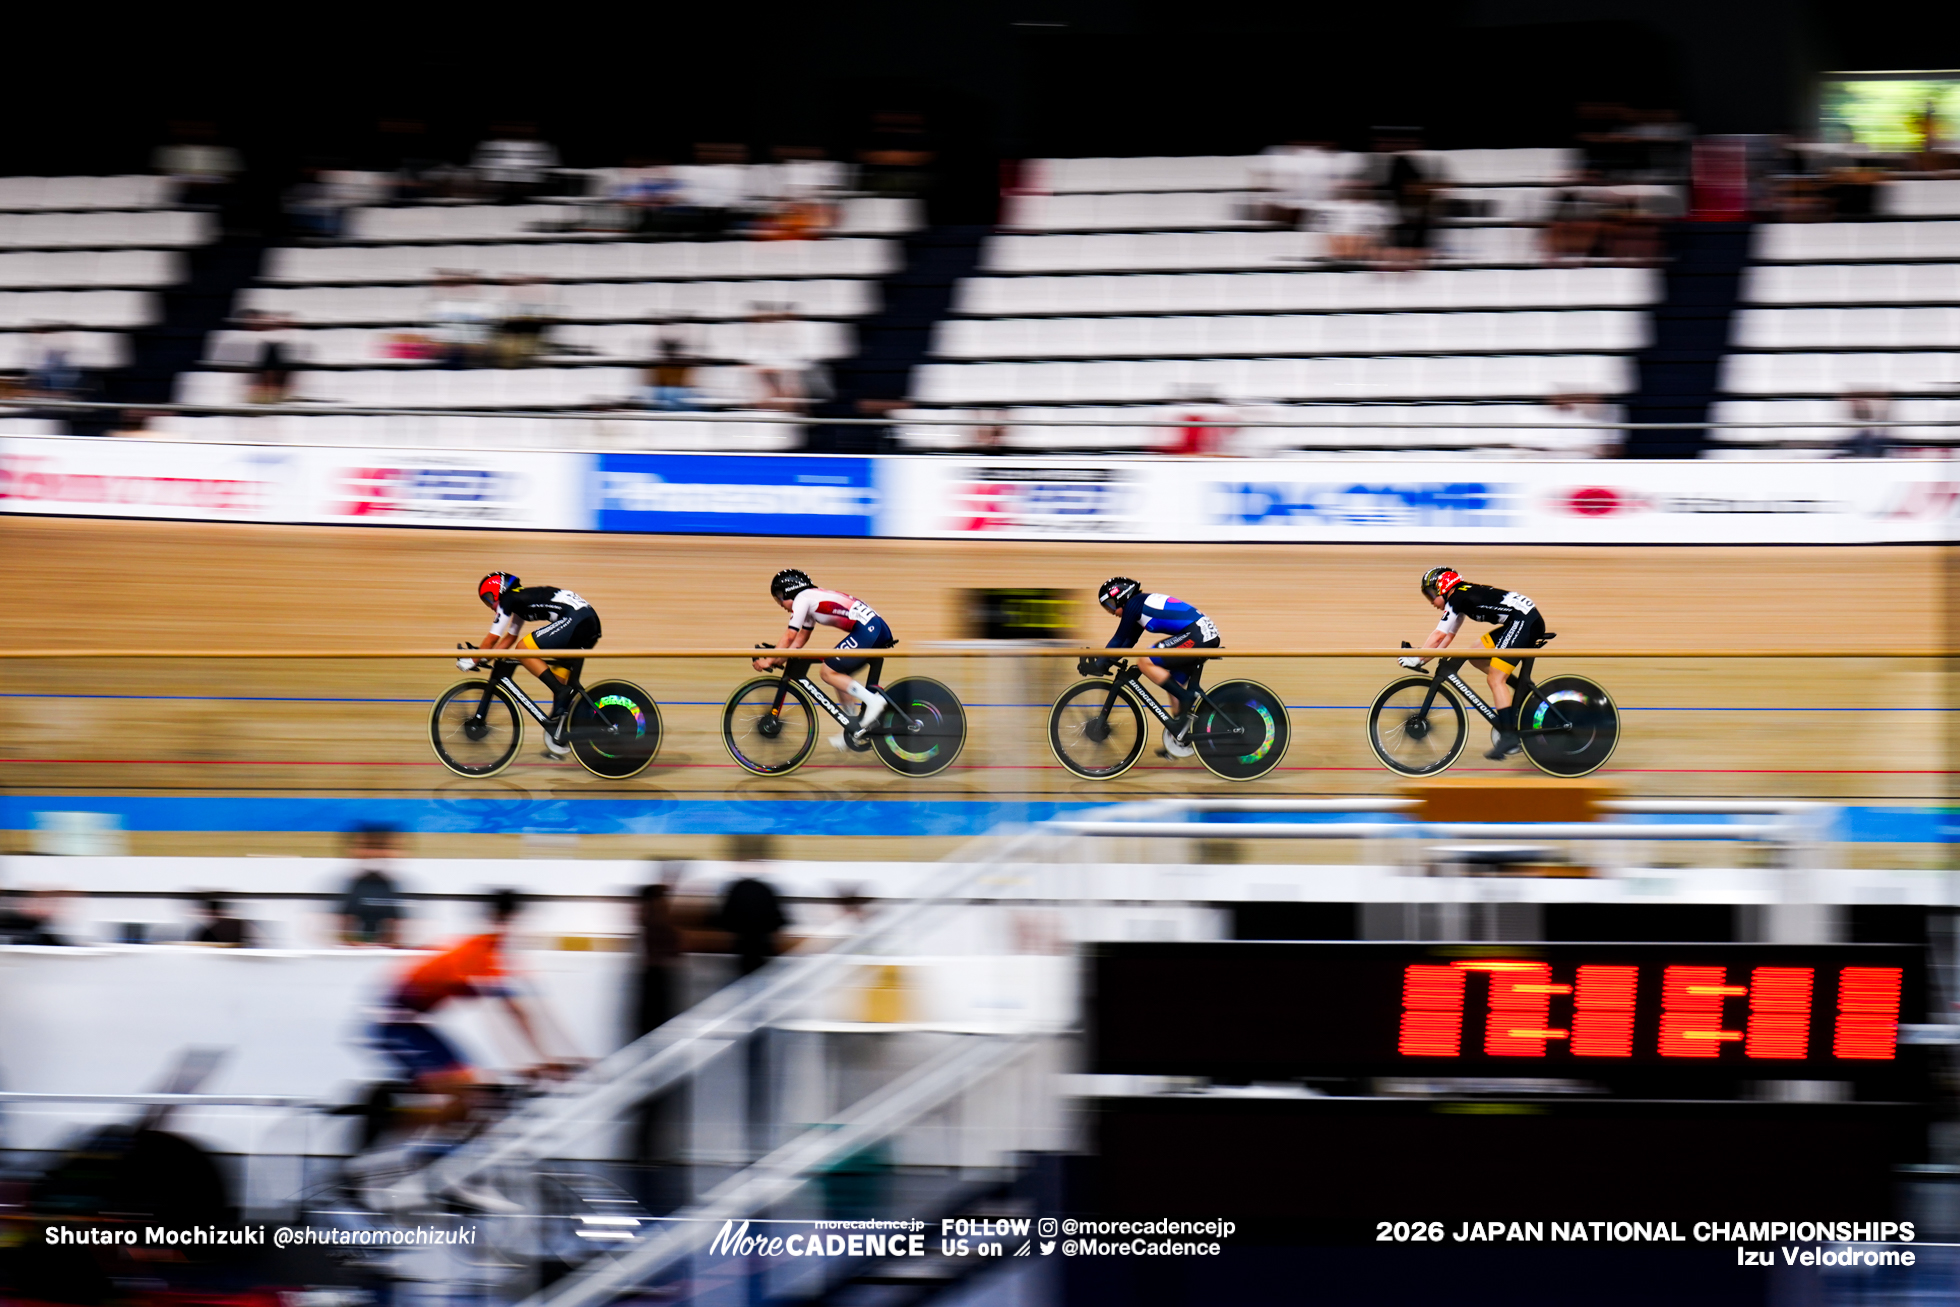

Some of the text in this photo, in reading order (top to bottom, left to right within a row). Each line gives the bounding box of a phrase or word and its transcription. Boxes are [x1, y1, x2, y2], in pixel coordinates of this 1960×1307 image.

[798, 679, 850, 726] ARGON 18
[1128, 679, 1169, 721] BRIDGESTONE
[1447, 673, 1496, 720] BRIDGESTONE
